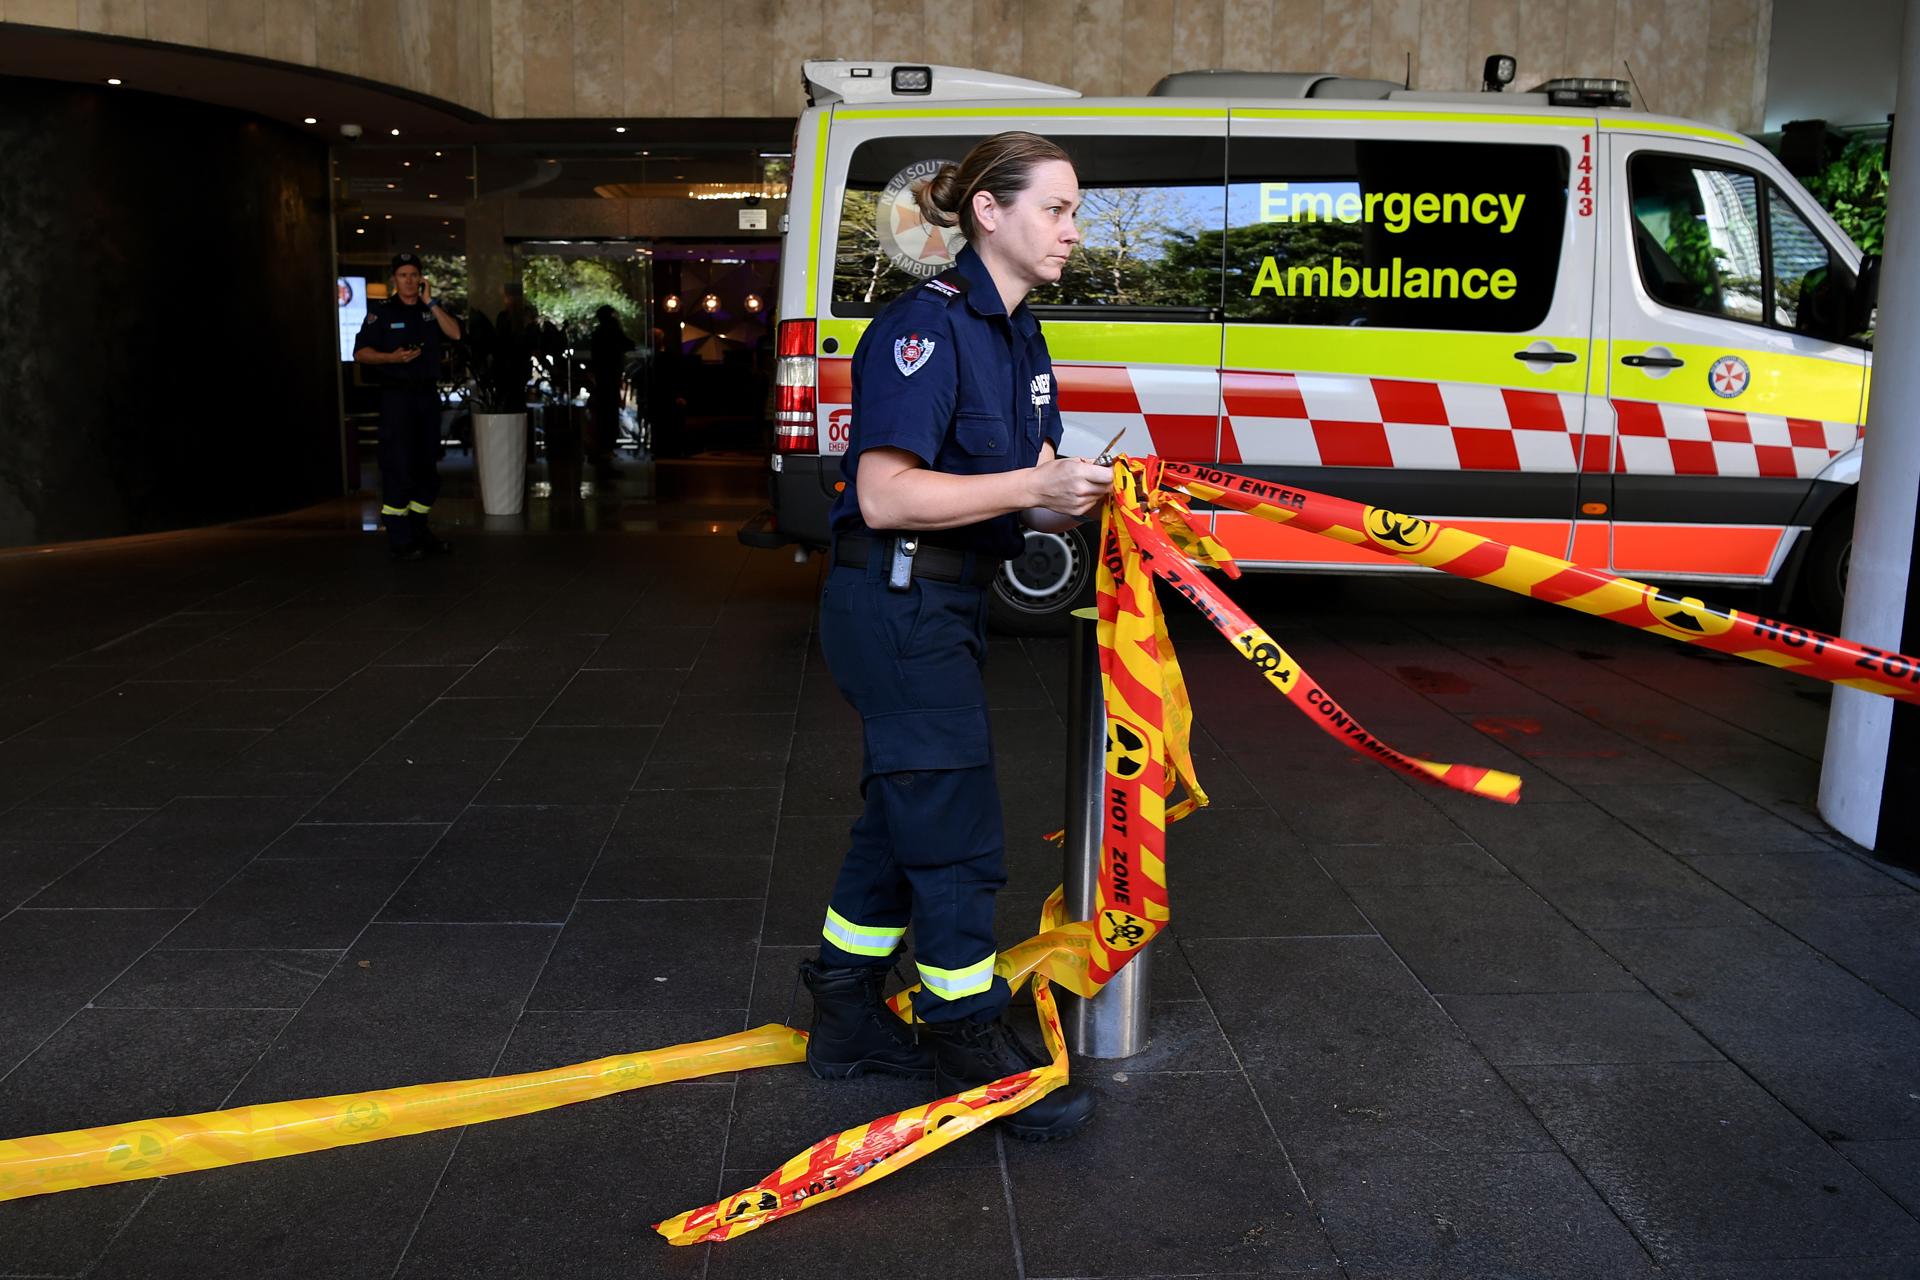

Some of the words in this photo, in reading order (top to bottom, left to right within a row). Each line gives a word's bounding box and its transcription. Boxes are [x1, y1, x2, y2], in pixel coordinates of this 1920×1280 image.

[881, 174, 906, 206] NEW
[906, 160, 947, 180] SOUT
[1577, 134, 1593, 217] 1443
[1259, 182, 1526, 233] Emergency
[892, 252, 958, 277] AMBULA
[1251, 256, 1518, 300] Ambulance
[829, 423, 850, 442] 00
[829, 442, 849, 452] EMERG
[1195, 467, 1237, 488] NOT
[1239, 479, 1307, 509] ENTER
[1753, 615, 1835, 655] HOT
[1855, 646, 1920, 684] ZO
[1111, 788, 1128, 838] HOT
[1112, 847, 1131, 906] ZONE
